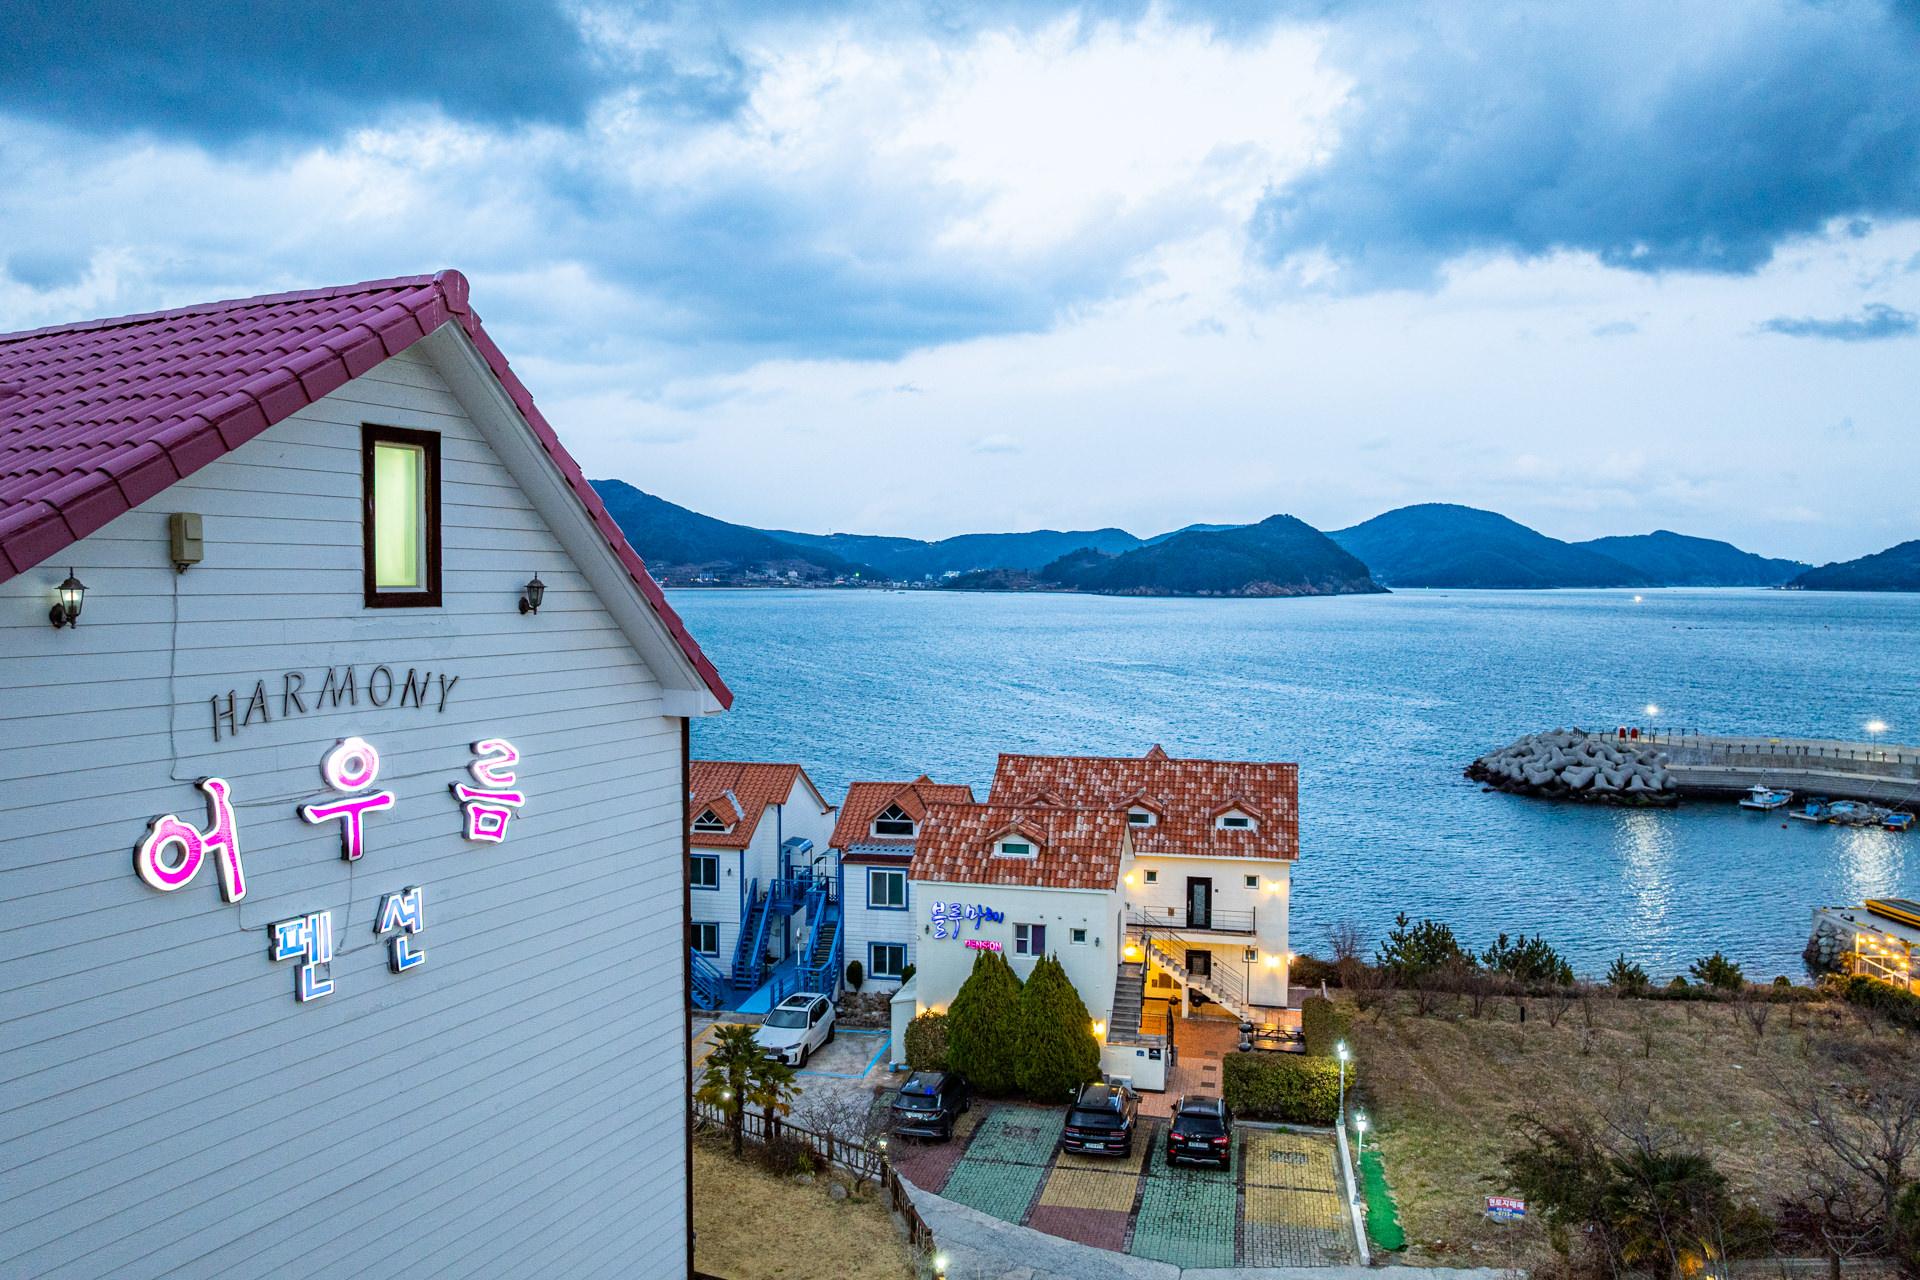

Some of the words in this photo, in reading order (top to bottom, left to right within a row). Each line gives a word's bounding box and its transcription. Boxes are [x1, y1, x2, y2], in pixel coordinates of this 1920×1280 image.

[209, 664, 460, 742] HARMONY
[134, 736, 526, 903] 어우름
[268, 886, 426, 1002] 펜션
[964, 939, 1002, 951] PENSION
